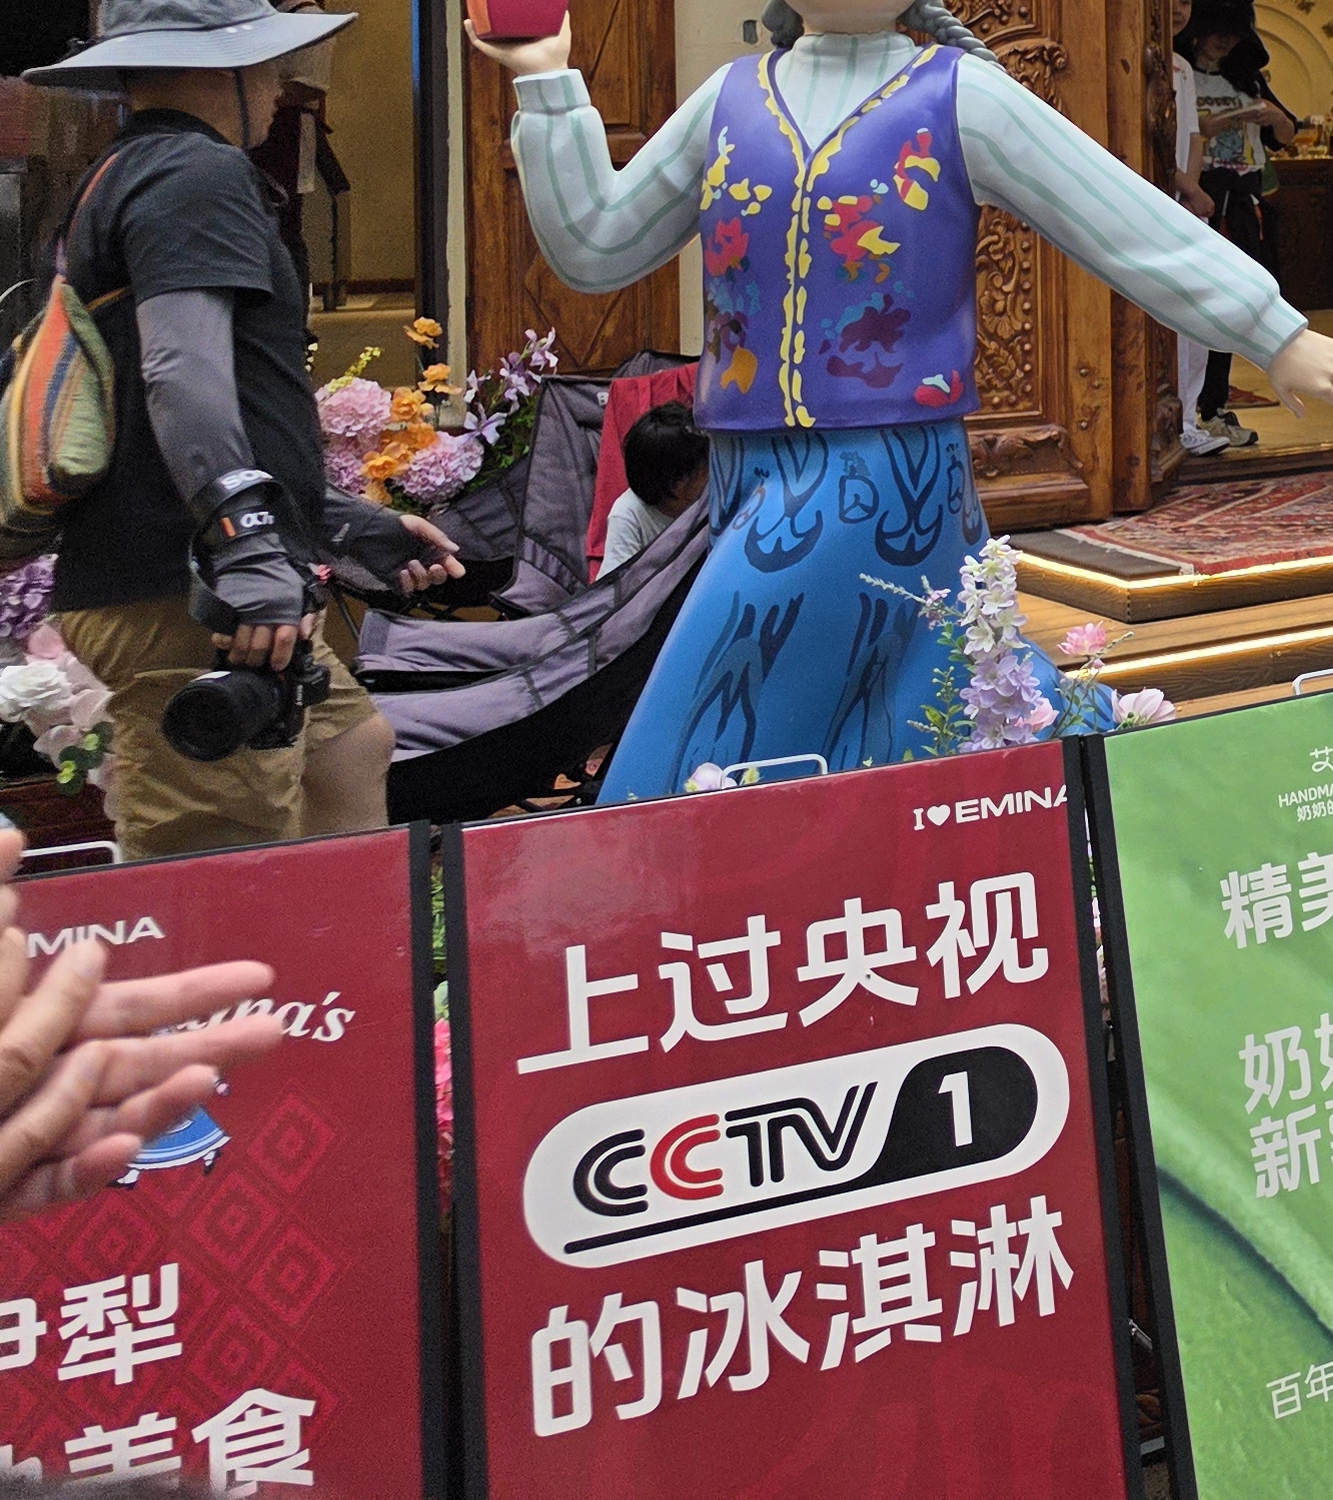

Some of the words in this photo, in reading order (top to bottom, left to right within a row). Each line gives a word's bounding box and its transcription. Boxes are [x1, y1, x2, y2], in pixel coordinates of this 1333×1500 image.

[27, 915, 165, 959] MINA
[517, 872, 1049, 1075] 上过央视
[573, 1082, 877, 1217] CCTV
[938, 1071, 975, 1147] 1
[531, 1195, 1075, 1437] 的冰淇淋
